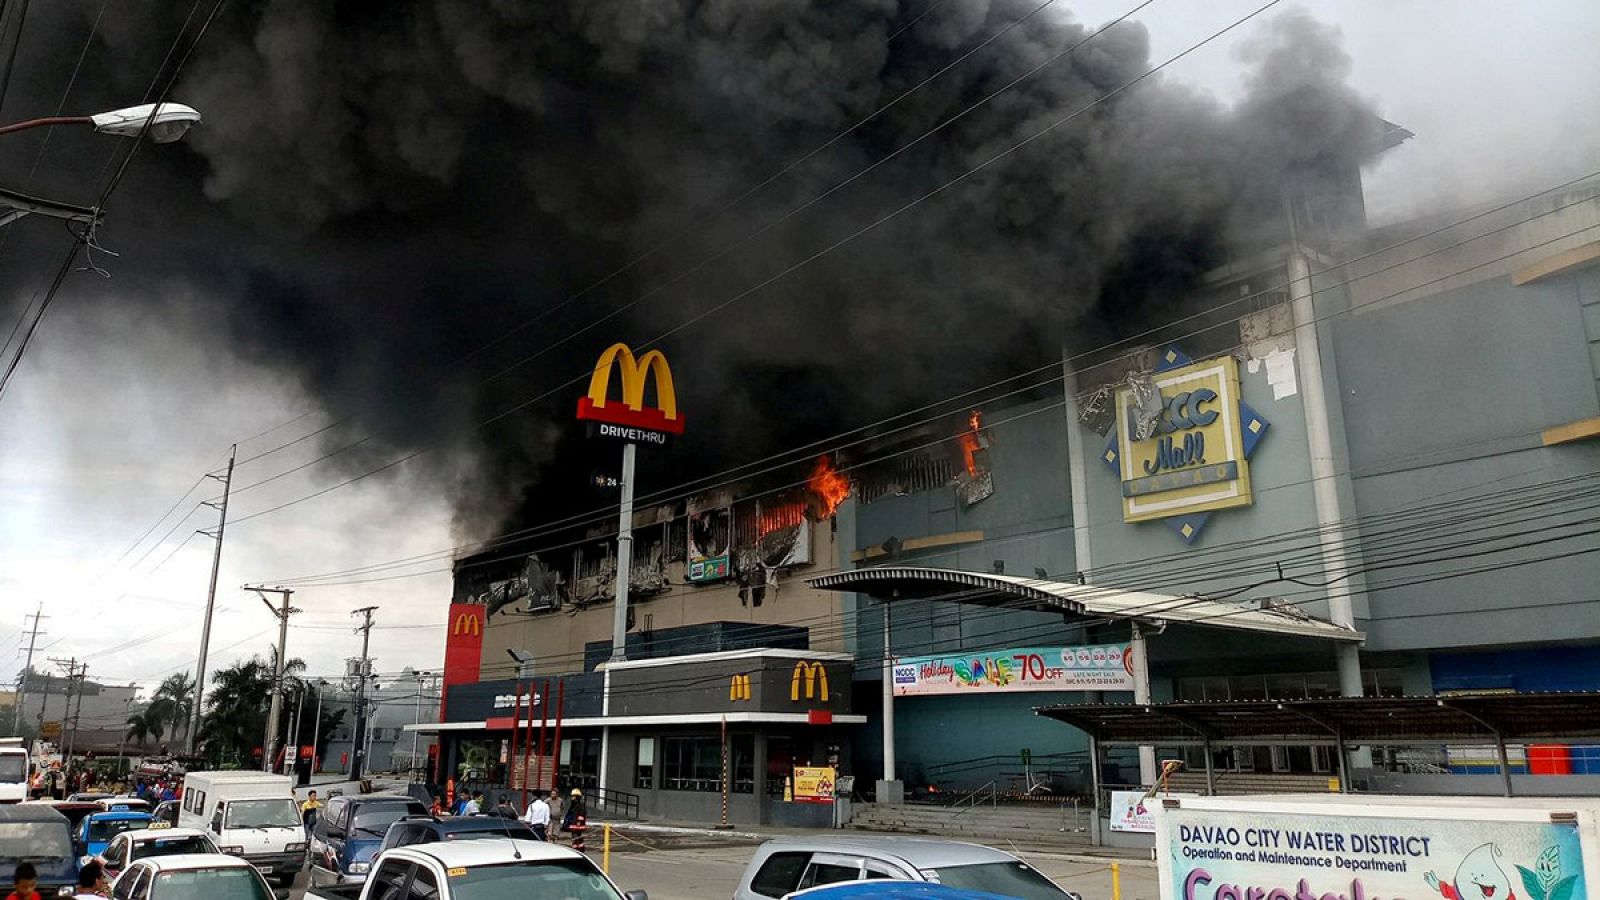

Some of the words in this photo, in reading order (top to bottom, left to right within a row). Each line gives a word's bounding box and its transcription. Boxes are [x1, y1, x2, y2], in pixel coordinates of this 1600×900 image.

[1143, 431, 1206, 475] Mall
[607, 478, 617, 486] 24
[920, 660, 954, 682] Holiday
[954, 657, 1013, 687] SALE
[1013, 654, 1044, 681] 70
[1045, 668, 1063, 679] OFF
[1180, 825, 1240, 845] DAVAO
[1245, 828, 1280, 848] CITY
[1285, 830, 1345, 852] WATER
[1351, 834, 1430, 856] DISTRICT
[1182, 845, 1233, 861] Operation
[1235, 850, 1256, 862] and
[1258, 851, 1332, 867] Maintenance
[1335, 855, 1407, 872] Department
